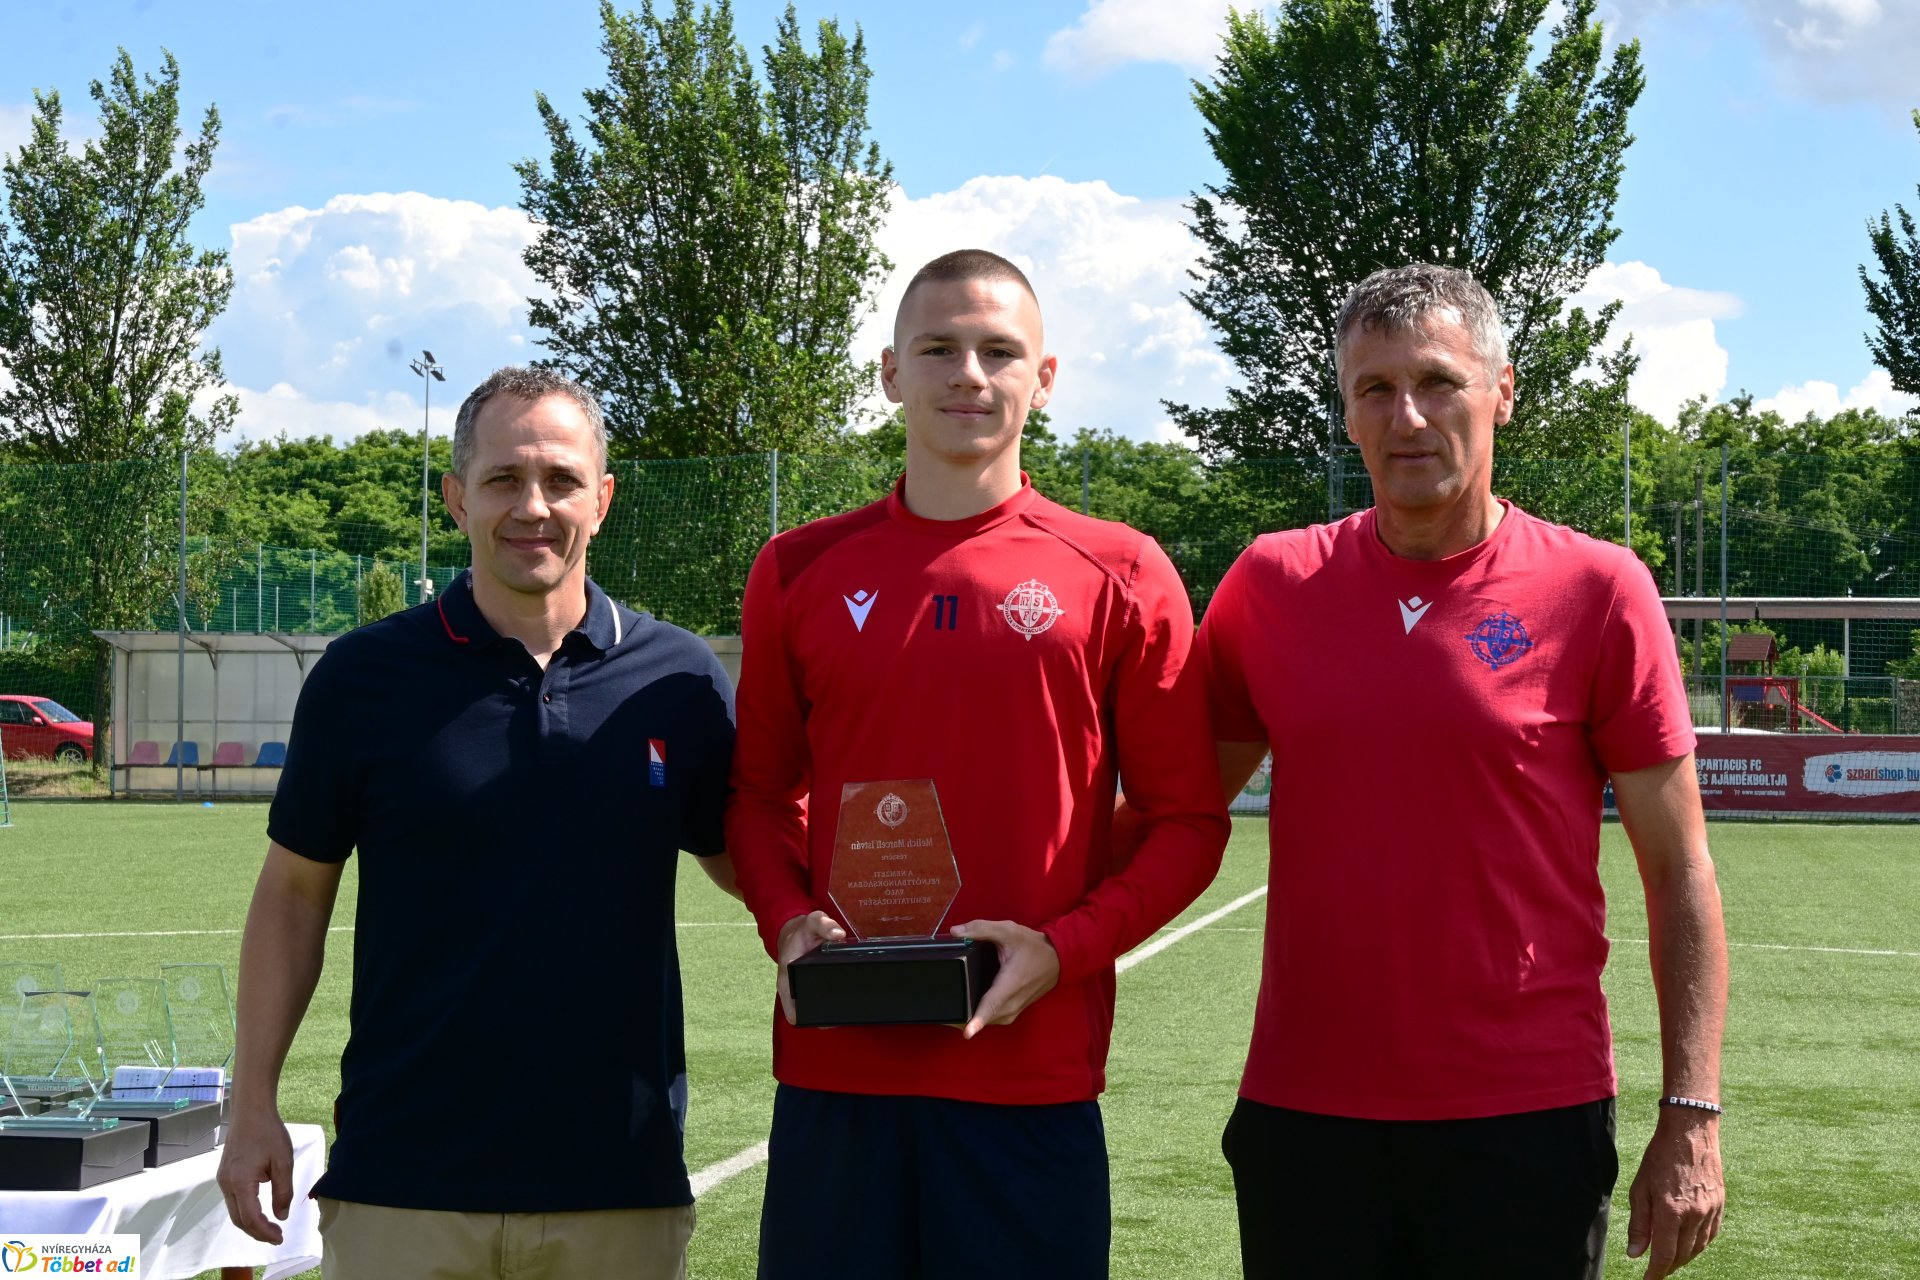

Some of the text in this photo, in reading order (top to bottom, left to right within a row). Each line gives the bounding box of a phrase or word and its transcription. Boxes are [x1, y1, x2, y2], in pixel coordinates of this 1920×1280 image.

[933, 595, 958, 630] 11
[1695, 759, 1762, 771] SPARTACUS FC
[1711, 771, 1788, 786] AJÁNDÉKBOLTJA
[1846, 767, 1920, 782] szparishop.hu
